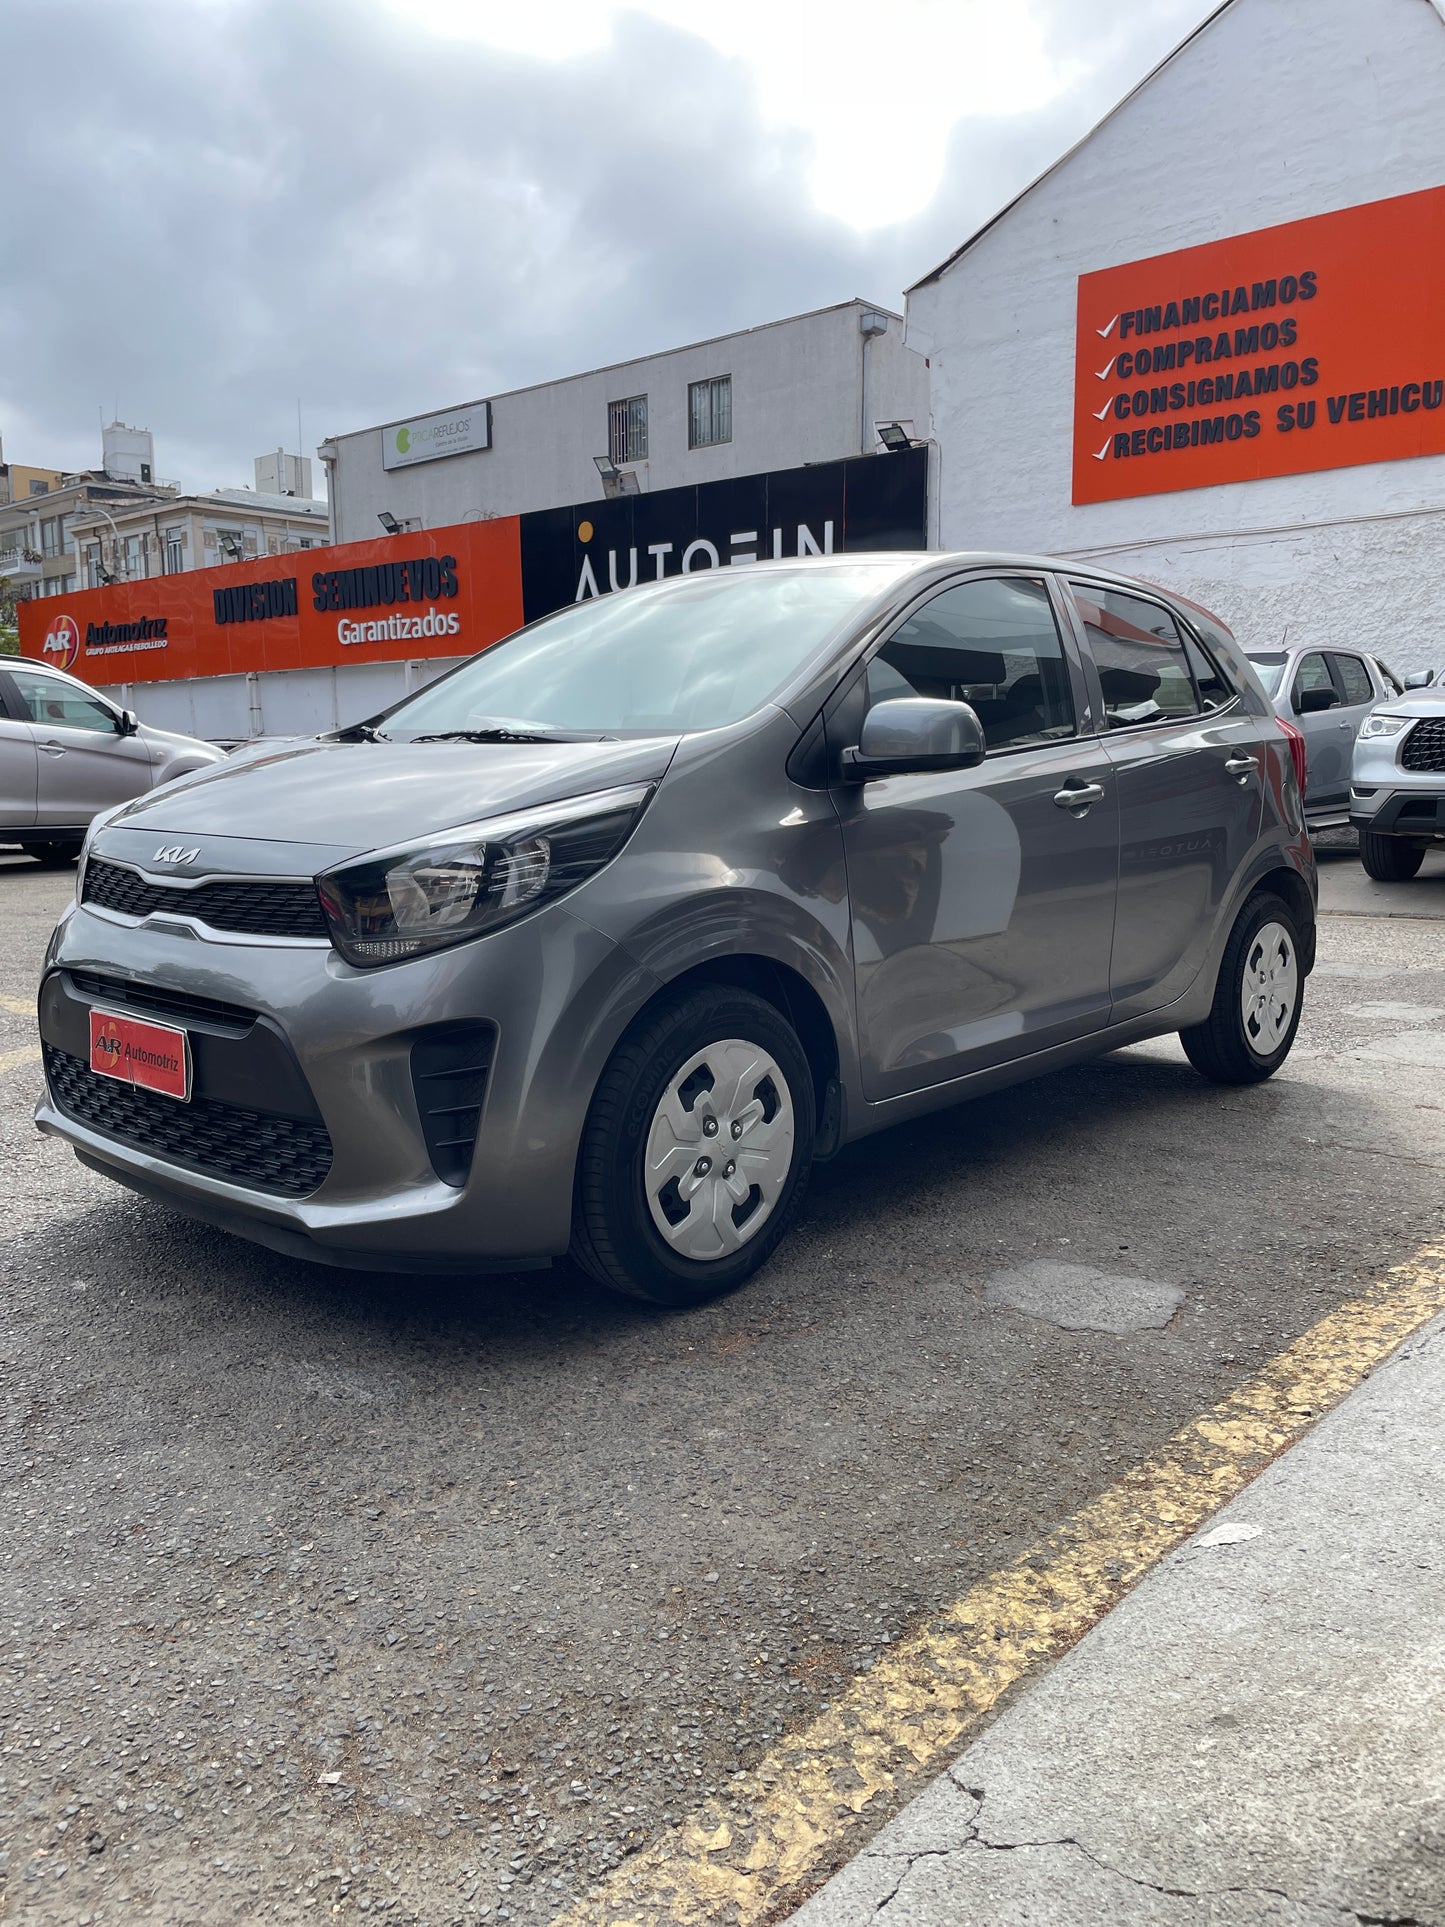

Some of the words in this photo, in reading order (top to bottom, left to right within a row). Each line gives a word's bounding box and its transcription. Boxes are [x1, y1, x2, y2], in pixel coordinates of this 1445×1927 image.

[1119, 270, 1317, 338] FINANCIAMOS
[1116, 318, 1297, 378] COMPRAMOS
[1114, 357, 1319, 419] CONSIGNAMOS
[1113, 410, 1261, 458] RECIBIMOS
[1276, 400, 1316, 432] SU
[1326, 380, 1443, 424] VEHICU
[213, 577, 298, 624] DIVISION
[312, 555, 459, 612] SEMINUEVOS
[85, 616, 168, 646] Automotriz
[338, 607, 460, 645] Garantizados
[85, 647, 104, 656] GRUPO
[153, 845, 201, 864] KIA
[124, 1043, 178, 1072] Automotriz
